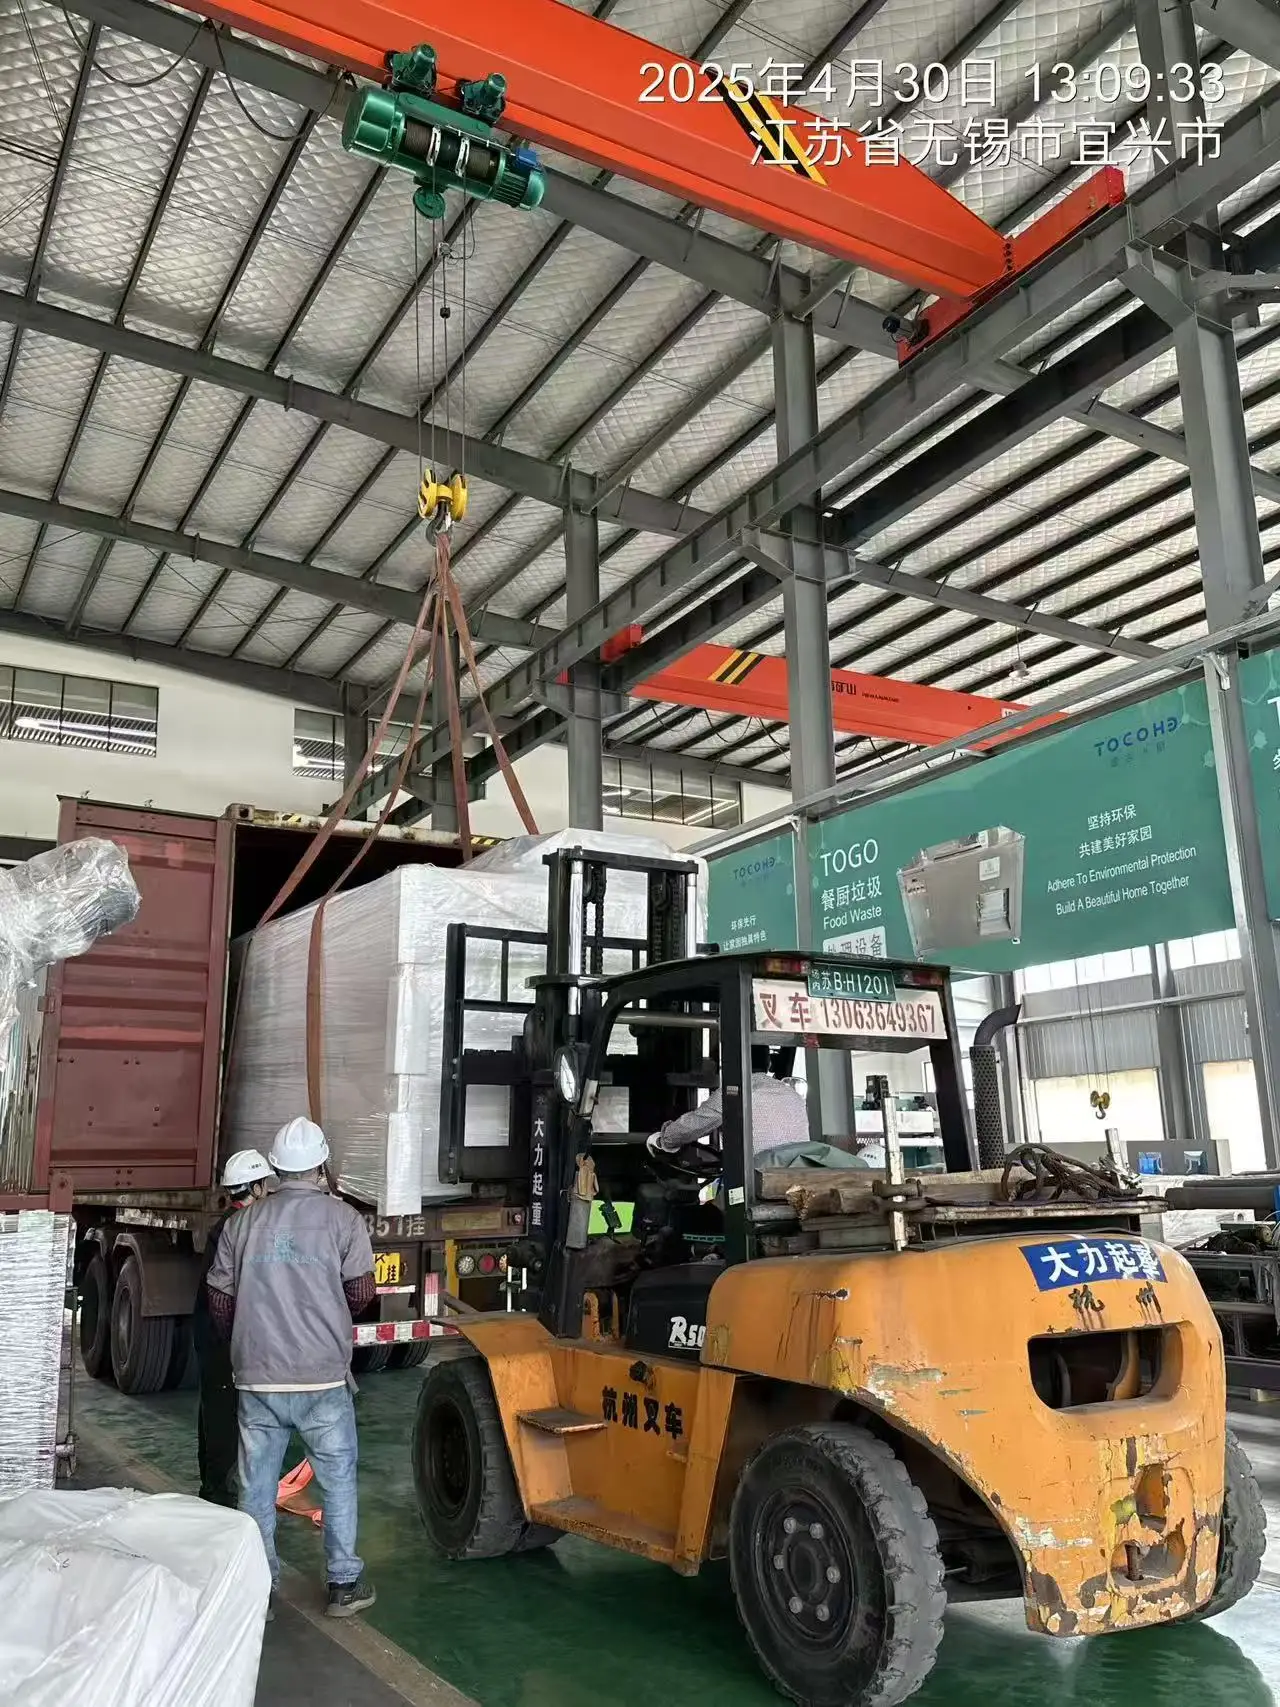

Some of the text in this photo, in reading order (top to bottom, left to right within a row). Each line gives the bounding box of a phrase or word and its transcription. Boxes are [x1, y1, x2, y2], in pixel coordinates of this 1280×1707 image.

[1087, 804, 1137, 831] 坚持环保
[820, 838, 879, 877] TOGO
[1079, 825, 1152, 858] 共建美好家园
[1047, 846, 1196, 893] Adhere To Environmental Protection
[821, 875, 882, 912] 餐厨垃圾
[1056, 874, 1190, 916] Build A Beautiful Home Together
[823, 905, 882, 930] Food Waste
[759, 992, 936, 1034] 叉车 13063649367
[532, 1117, 545, 1227] 大力起重
[602, 1385, 683, 1440] 杭州叉车
